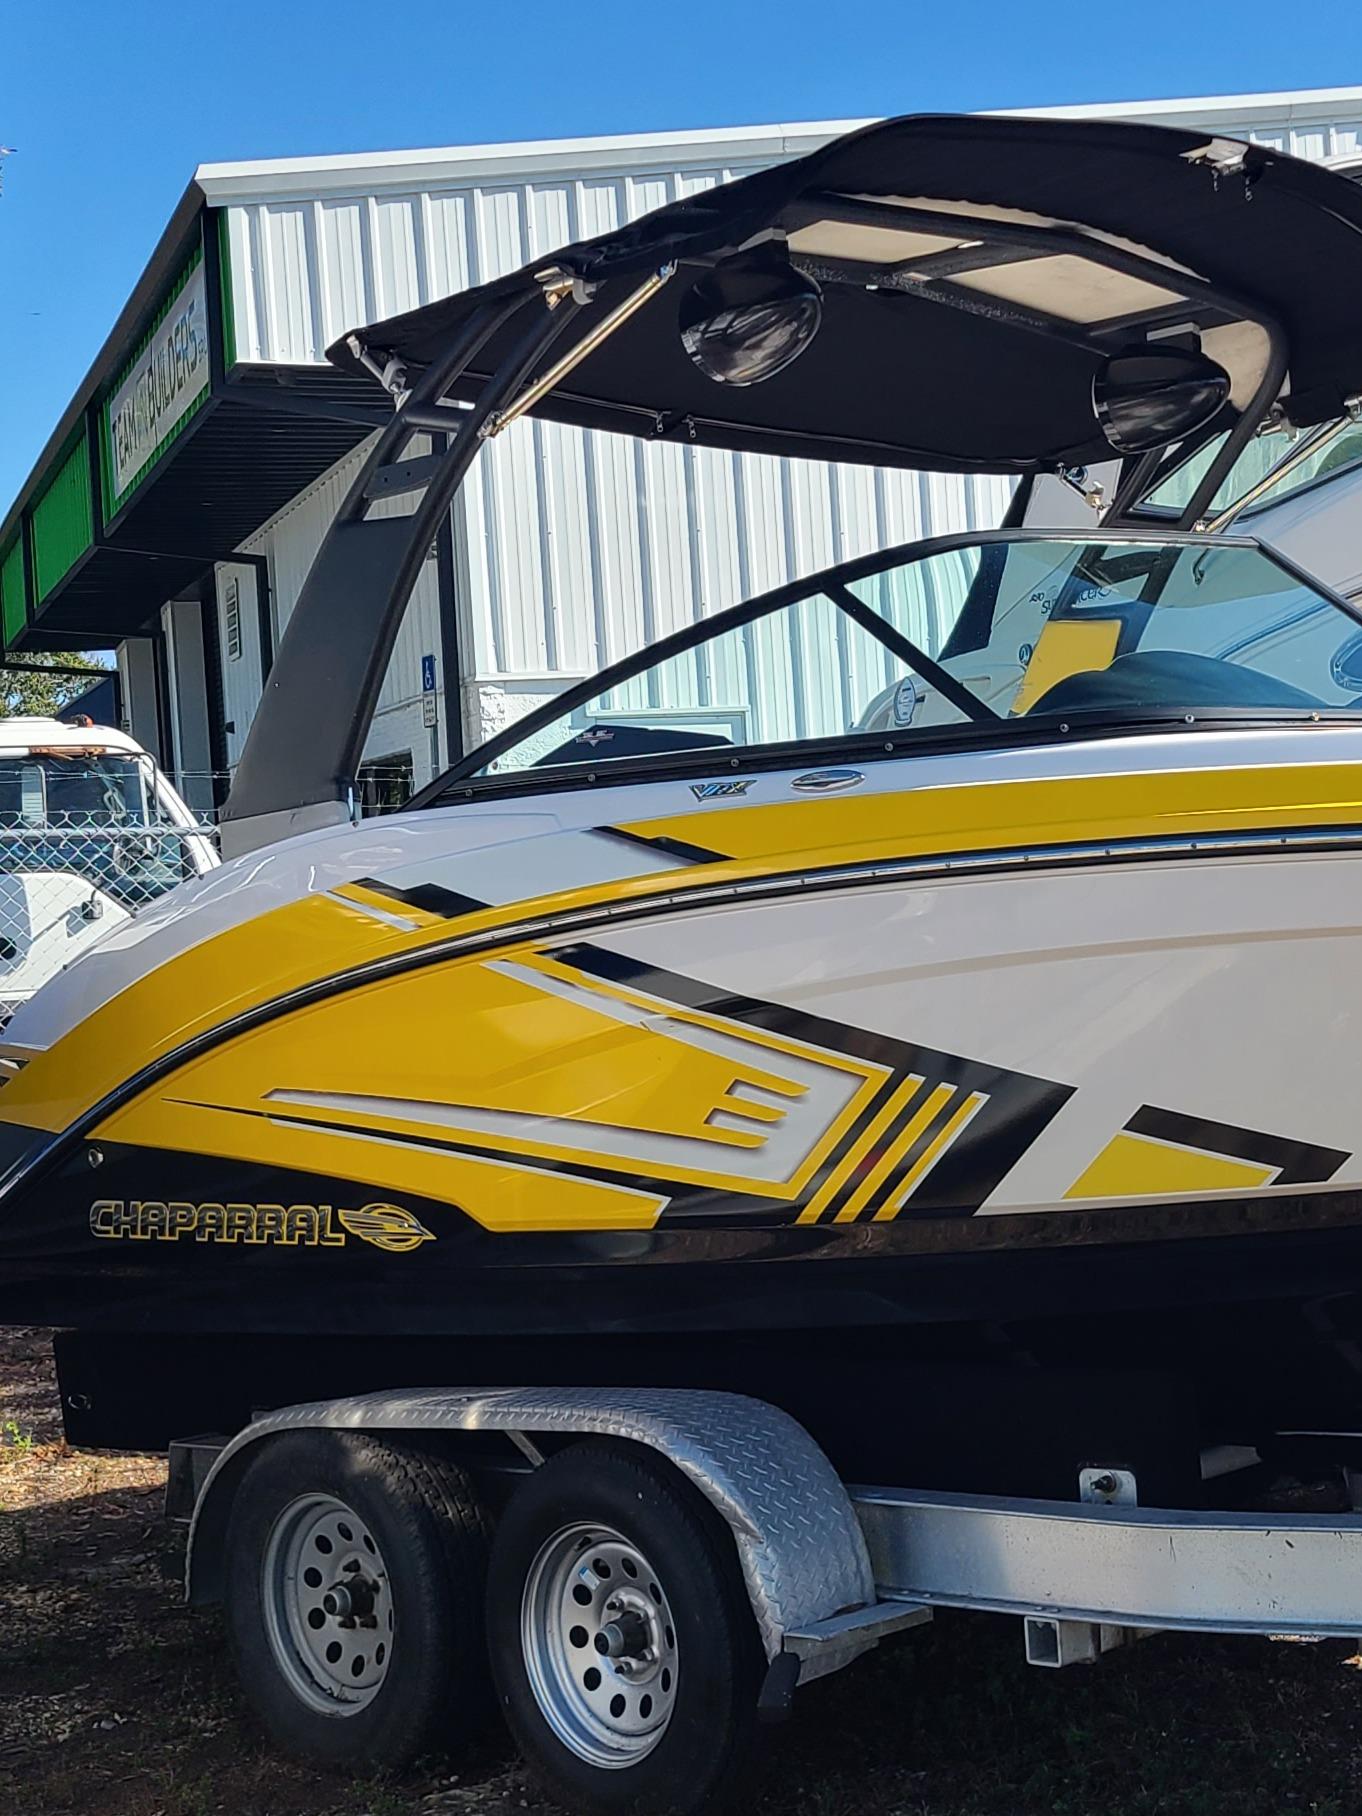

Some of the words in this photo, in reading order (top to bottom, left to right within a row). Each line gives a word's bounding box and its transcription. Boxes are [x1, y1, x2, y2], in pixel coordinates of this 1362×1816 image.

[112, 393, 138, 476] TEAM
[147, 299, 198, 430] BUILDERS
[89, 1200, 346, 1246] CHAPARRAL
